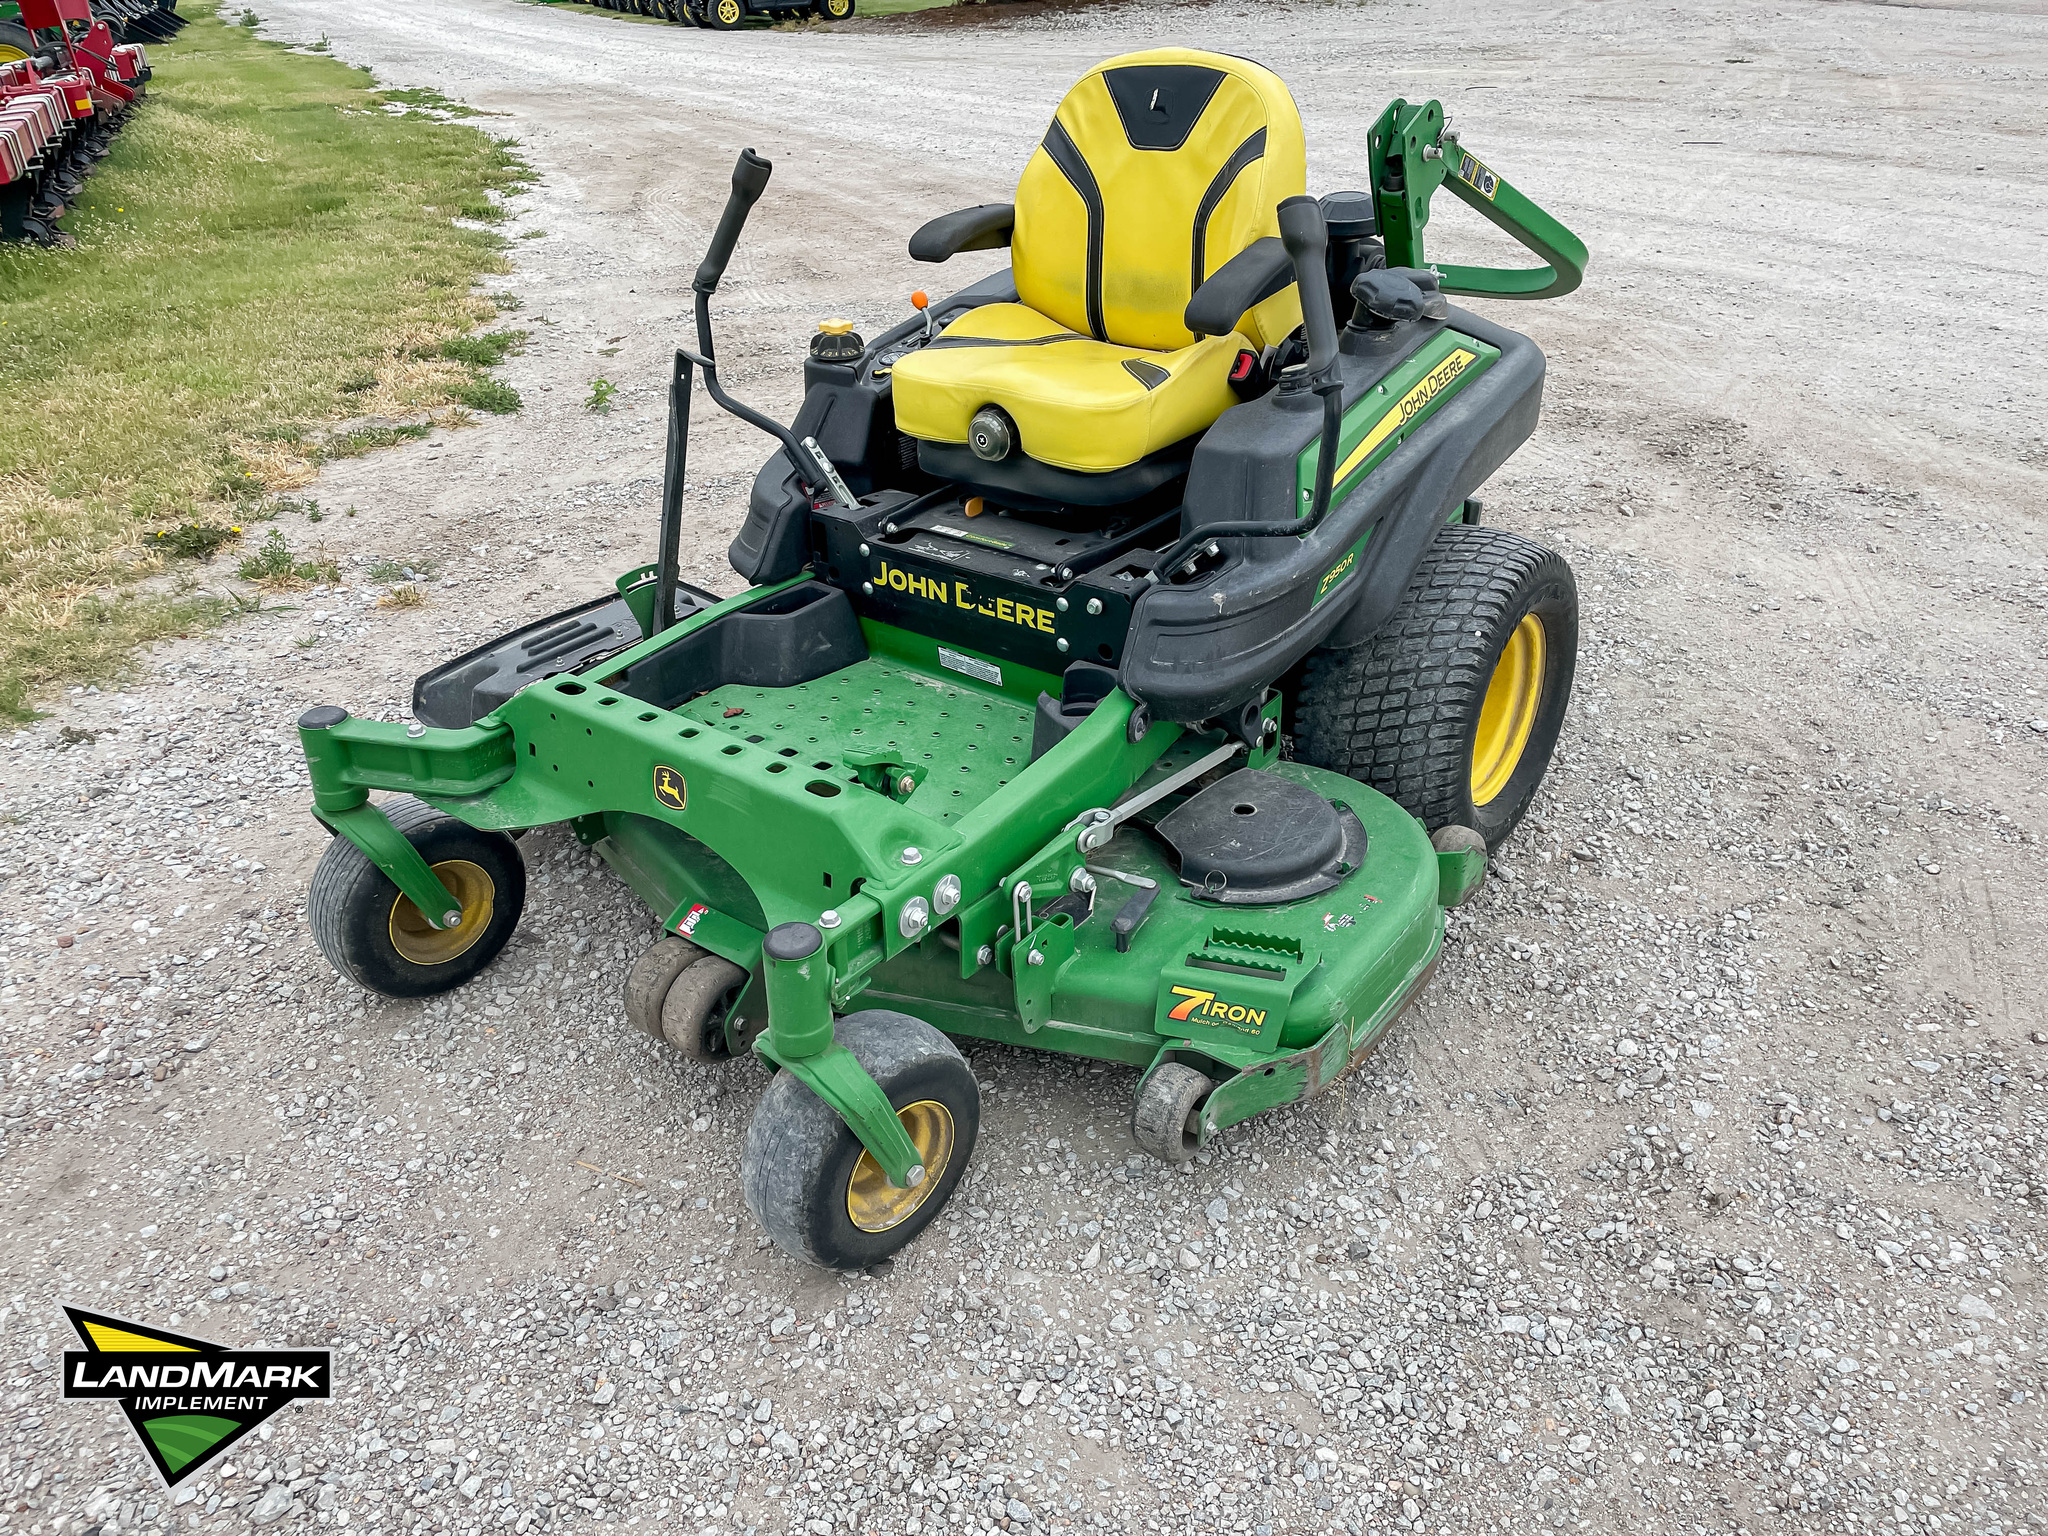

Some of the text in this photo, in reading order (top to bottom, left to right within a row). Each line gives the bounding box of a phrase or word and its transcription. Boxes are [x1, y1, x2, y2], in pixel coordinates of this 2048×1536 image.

[1399, 354, 1464, 423] JOHN DEERE
[873, 561, 947, 603] JOHN
[1320, 552, 1354, 594] Z950R
[1190, 1016, 1211, 1026] Mulch
